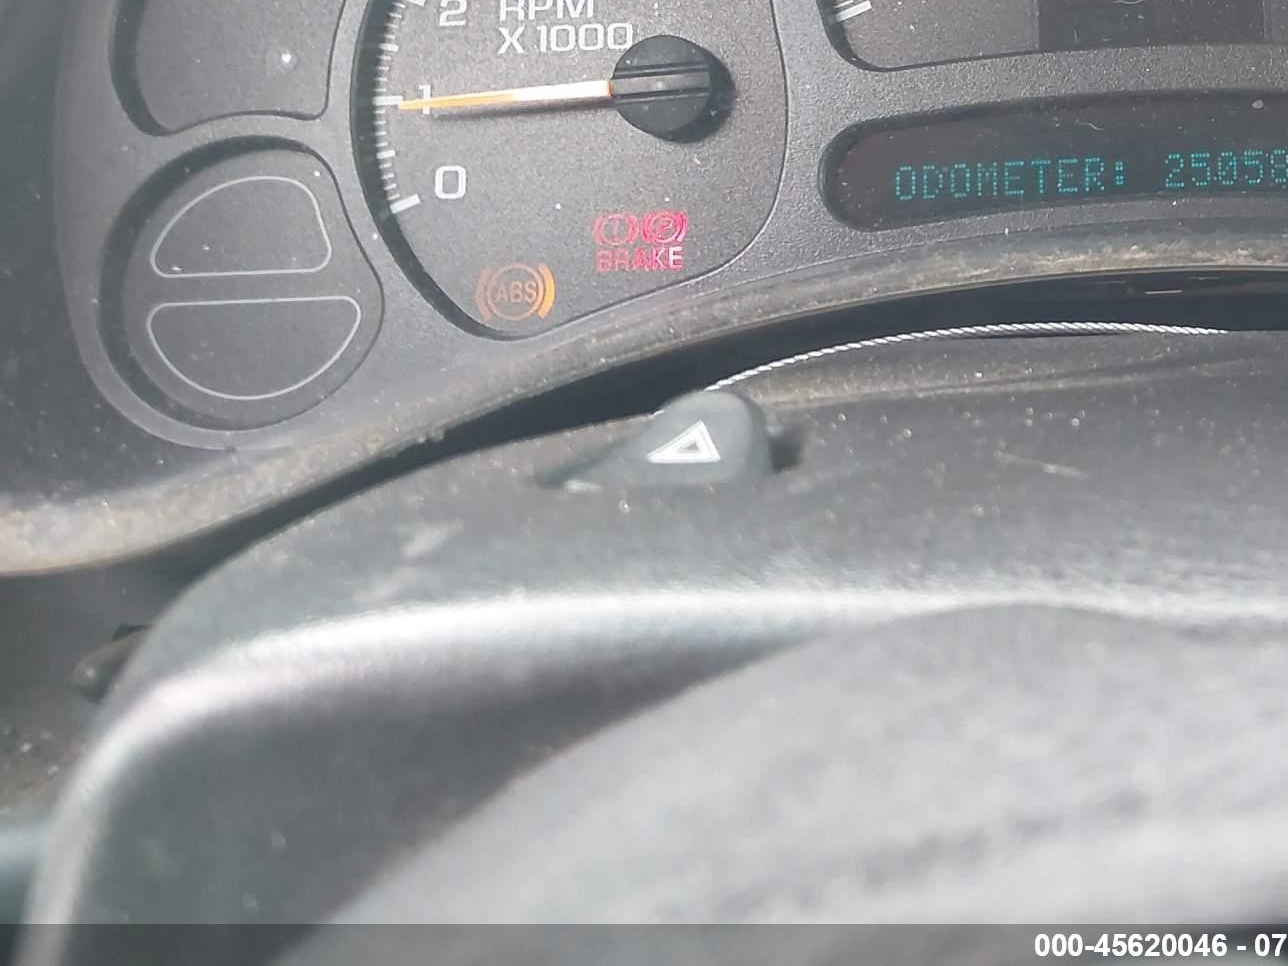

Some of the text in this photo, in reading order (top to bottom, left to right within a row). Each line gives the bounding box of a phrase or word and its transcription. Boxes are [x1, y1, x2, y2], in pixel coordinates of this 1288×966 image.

[497, 20, 634, 55] X 1000
[434, 165, 467, 200] 0
[895, 158, 1126, 200] ODOMETER:
[597, 246, 683, 272] BRAKE
[495, 282, 537, 303] ABS
